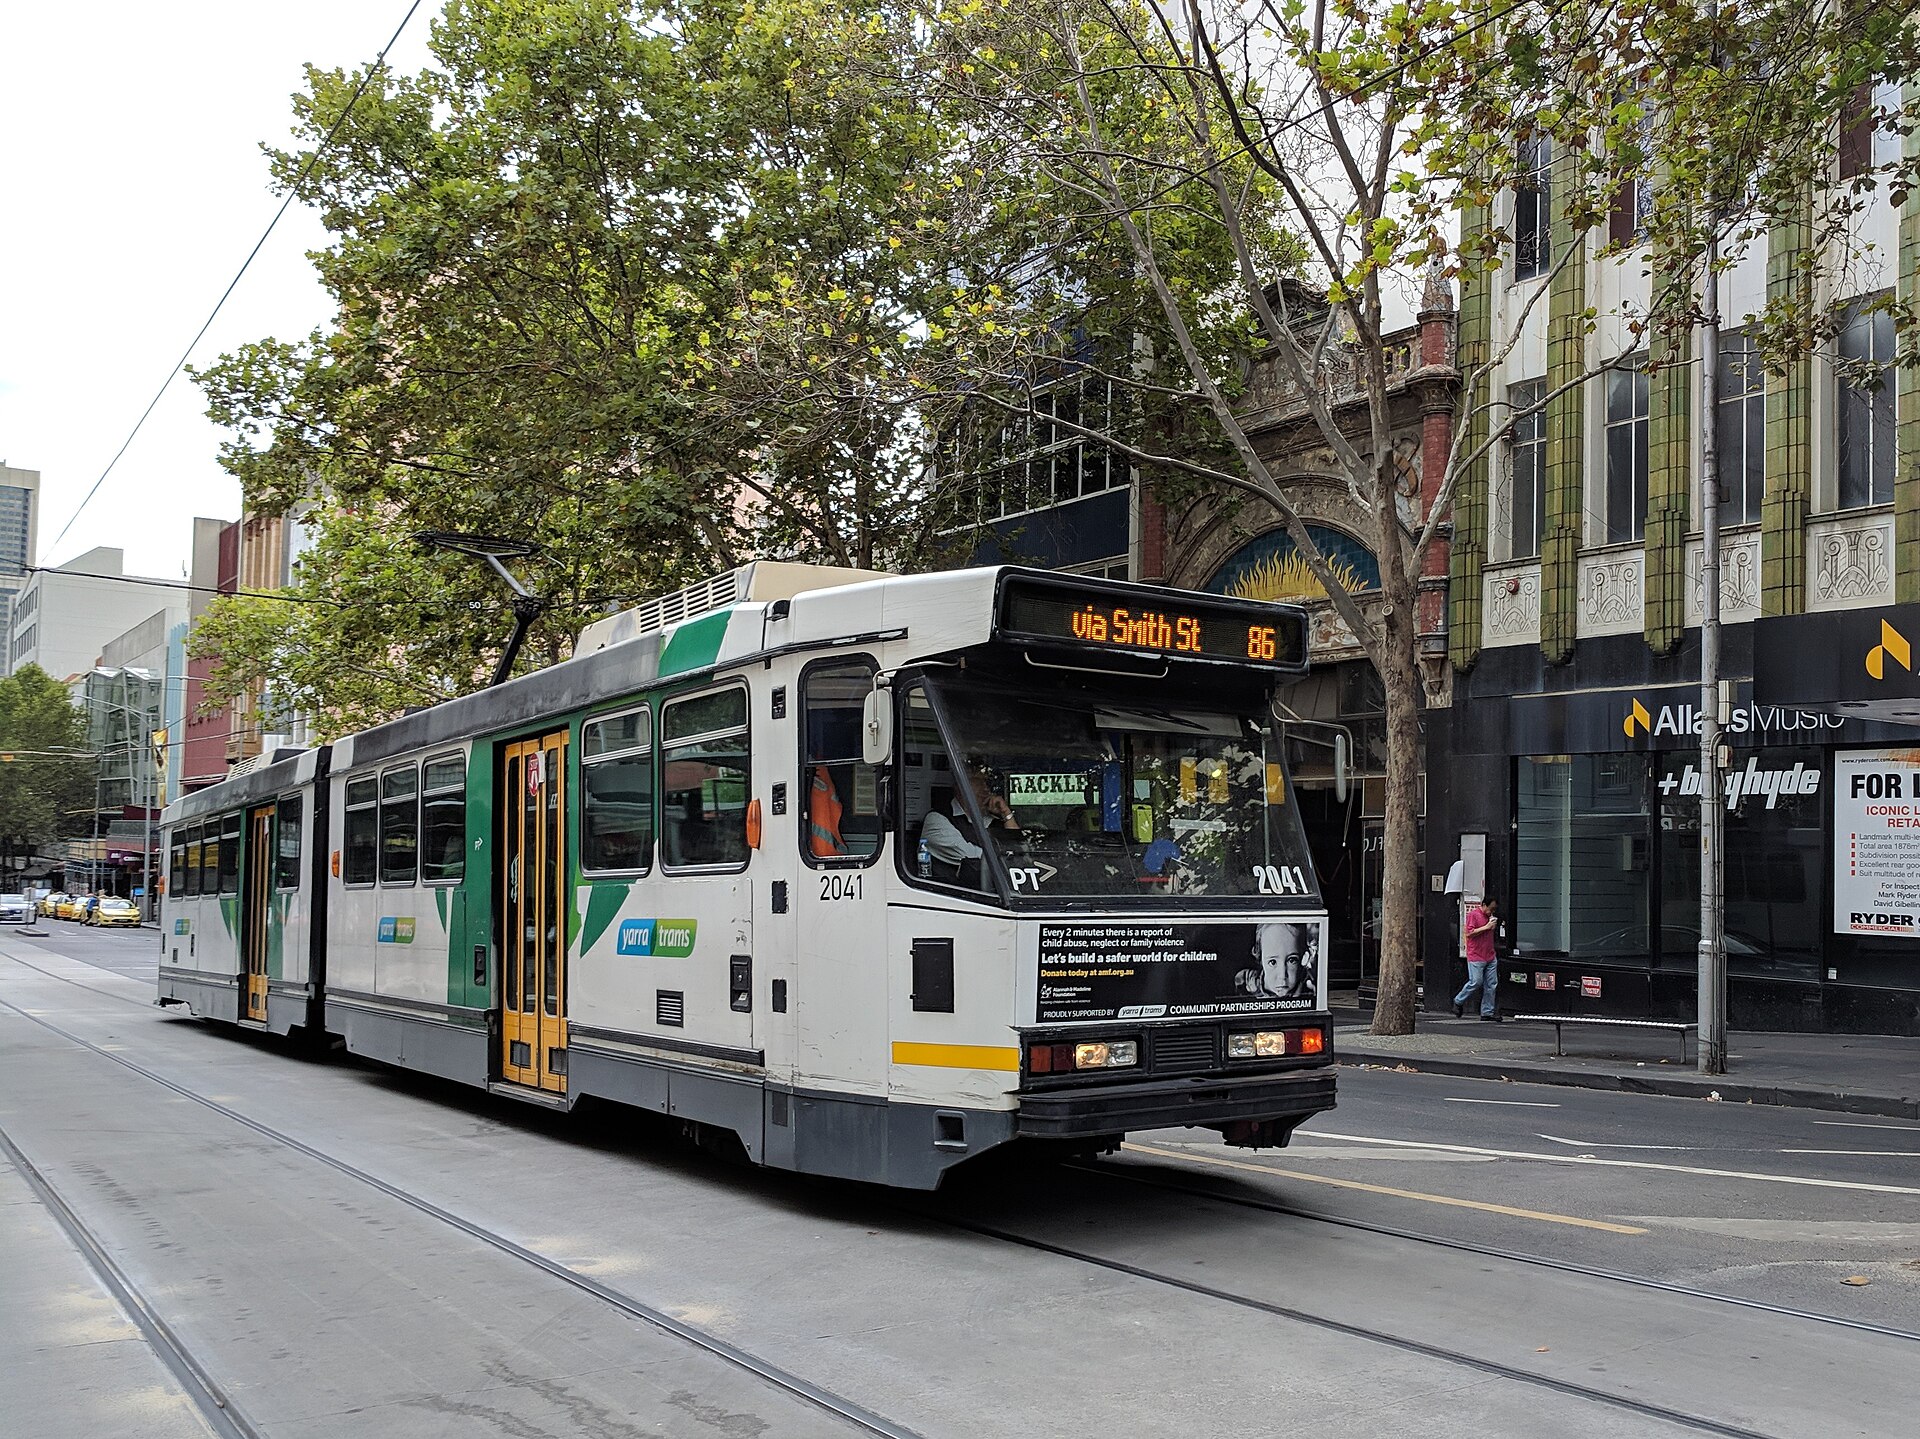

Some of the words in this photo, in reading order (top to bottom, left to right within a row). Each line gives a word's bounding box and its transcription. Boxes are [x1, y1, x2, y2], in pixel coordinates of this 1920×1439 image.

[468, 601, 481, 609] 50
[1071, 605, 1107, 641] via
[1112, 608, 1171, 649] Smith
[1176, 617, 1202, 652] St
[1247, 626, 1275, 660] 86
[1850, 773, 1902, 799] FOR
[1866, 805, 1910, 816] ICONIC
[1859, 833, 1893, 841] Landmark
[1860, 842, 1876, 850] Total
[1859, 851, 1898, 859] Subdivision
[1859, 860, 1890, 868] Excellent
[1859, 869, 1873, 877] Suit
[1874, 870, 1906, 878] multitude
[1907, 870, 1915, 878] of
[1252, 865, 1310, 895] 2041
[819, 874, 863, 901] 2041
[1878, 891, 1896, 899] Mark
[1897, 892, 1918, 900] Ryder
[1874, 899, 1893, 907] David
[1850, 912, 1914, 927] RYDER
[1042, 928, 1065, 938] Every
[1066, 928, 1072, 936] 2
[1073, 927, 1105, 937] minutes
[1105, 928, 1126, 937] there
[1127, 928, 1134, 936] is
[1140, 928, 1164, 938] report
[1164, 928, 1173, 936] of
[622, 927, 649, 951] yarra
[659, 928, 690, 948] trams
[1042, 938, 1062, 947] child
[1063, 939, 1089, 948] abuse,
[1090, 938, 1120, 949] neglect
[1130, 938, 1154, 948] family
[1154, 938, 1185, 946] violence
[1041, 953, 1067, 964] Let's
[1068, 953, 1096, 964] build
[1105, 953, 1131, 963] safer
[1132, 952, 1161, 962] world
[1162, 952, 1179, 962] for
[1179, 951, 1218, 962] children
[1068, 969, 1089, 977] today
[1098, 968, 1135, 977] amf.org.au
[1122, 1008, 1139, 1016] yarra
[1169, 1004, 1220, 1015] COMMUNITY
[1220, 1001, 1276, 1012] PARTNERSHIPS
[1276, 999, 1312, 1009] PROGRAM
[1043, 1010, 1072, 1018] PROUDLY
[1072, 1009, 1106, 1018] SUPPORTED
[1106, 1008, 1115, 1016] BY
